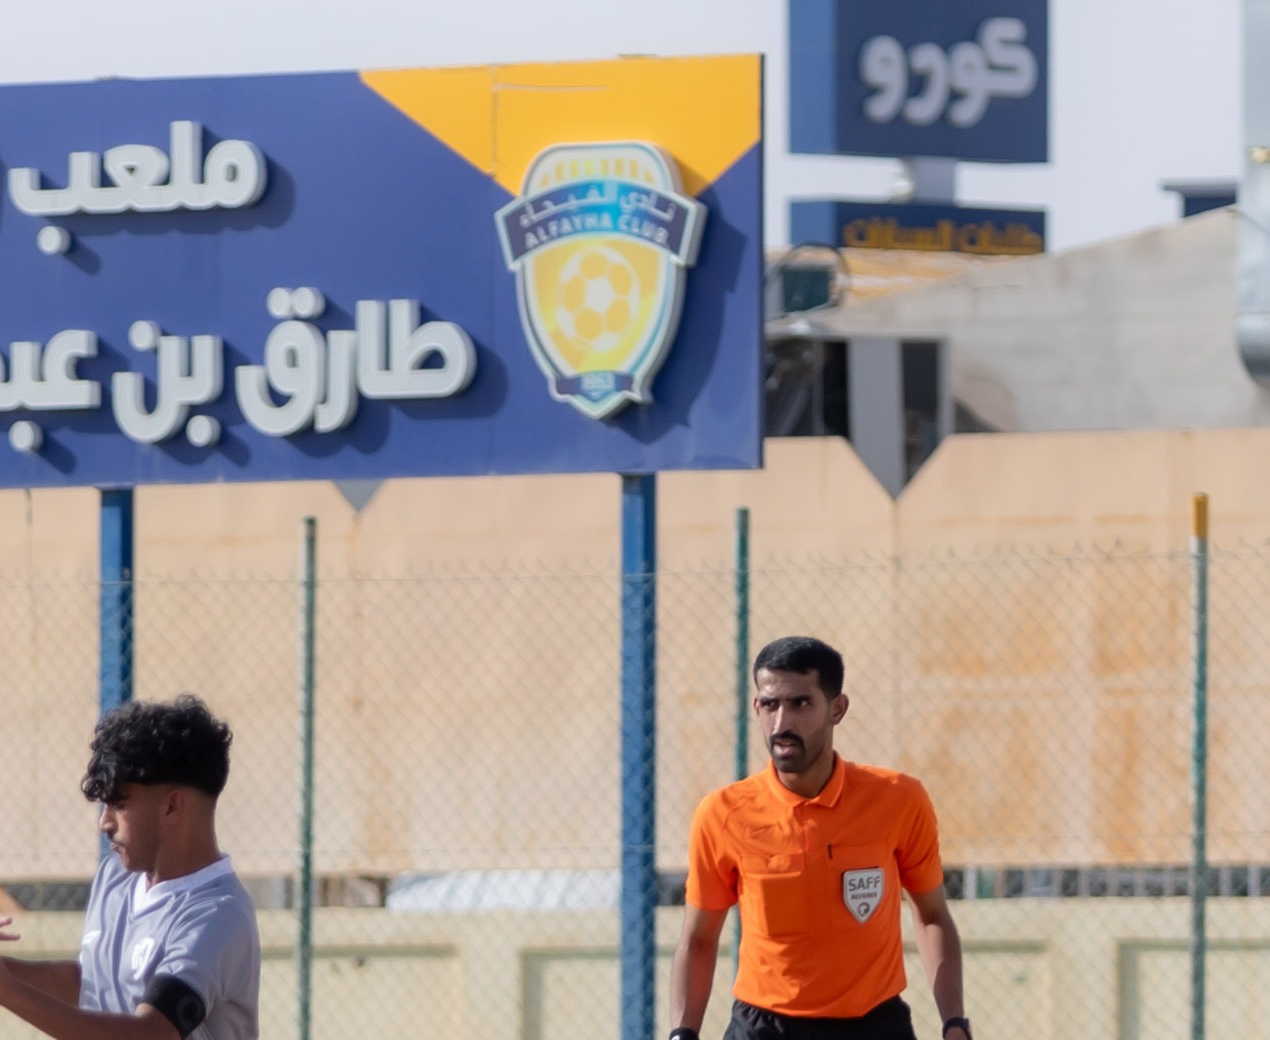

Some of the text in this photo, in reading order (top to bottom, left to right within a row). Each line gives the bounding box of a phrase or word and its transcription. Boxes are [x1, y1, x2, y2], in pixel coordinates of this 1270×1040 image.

[9, 121, 268, 255] ملعب
[524, 212, 670, 249] ALFAYHA CLUB
[112, 320, 224, 448] بن
[235, 287, 476, 437] طارق
[848, 876, 881, 891] SAFF
